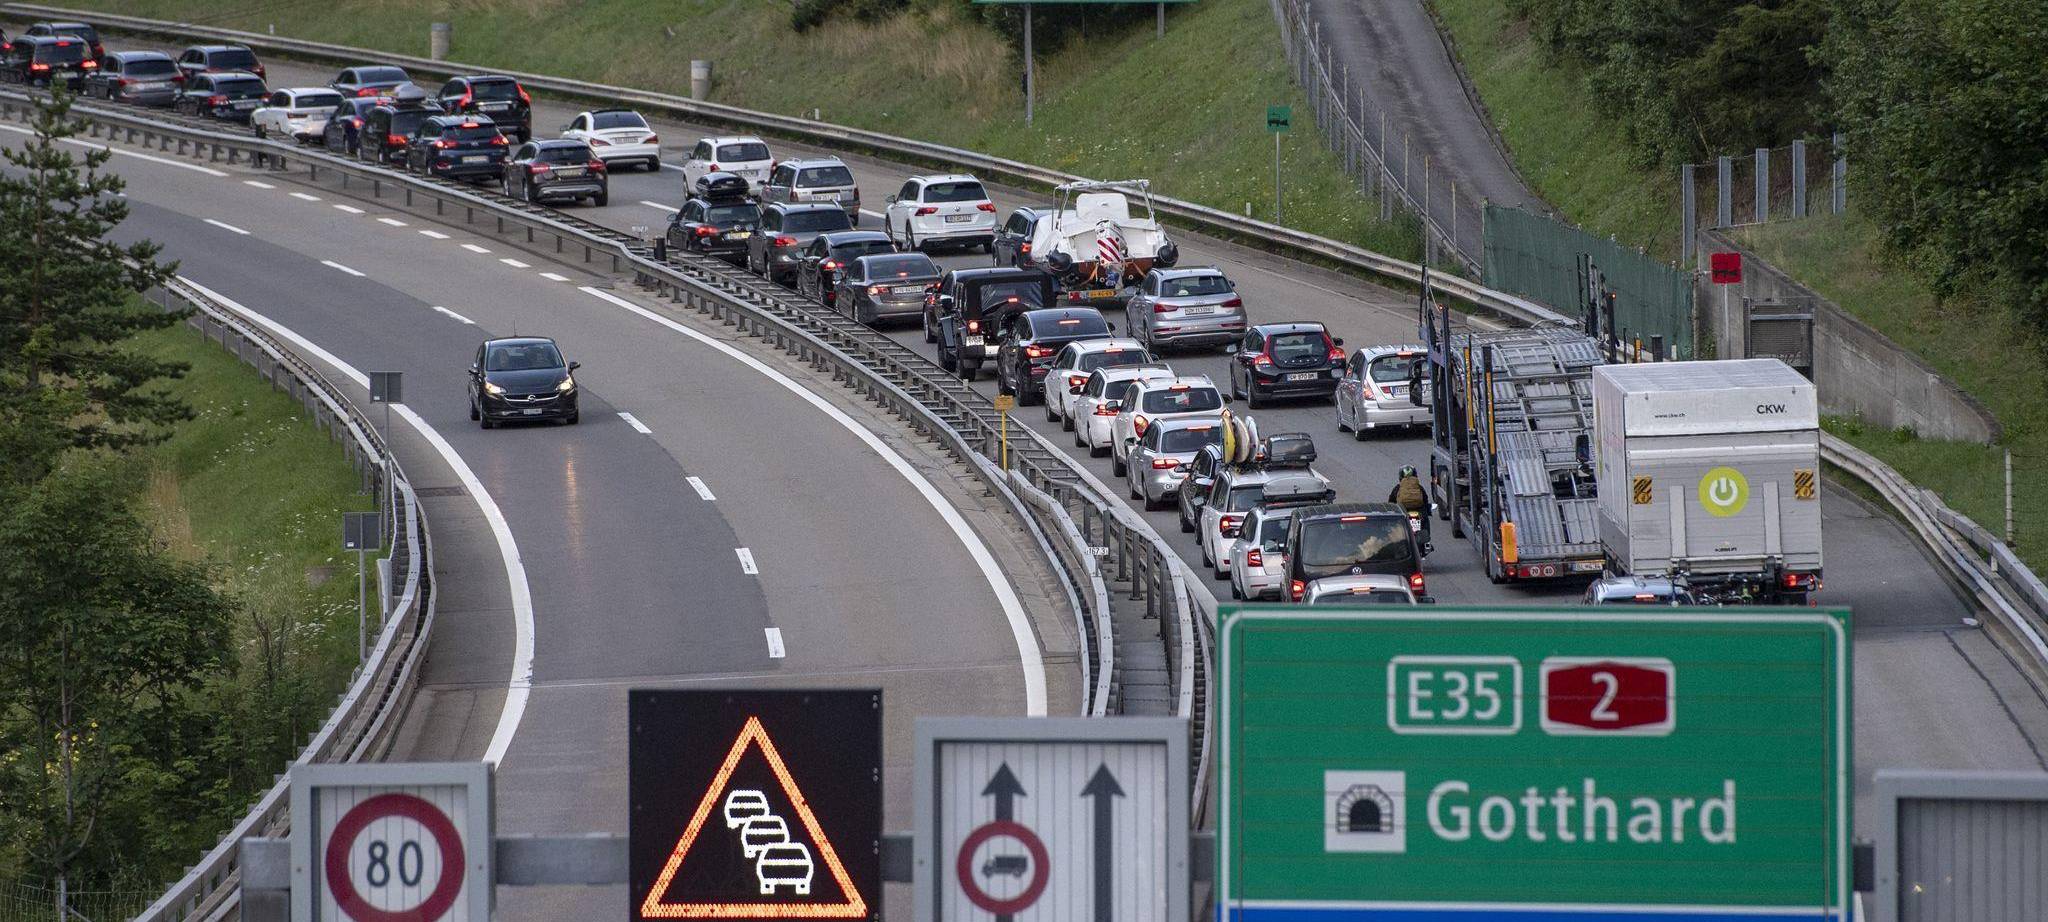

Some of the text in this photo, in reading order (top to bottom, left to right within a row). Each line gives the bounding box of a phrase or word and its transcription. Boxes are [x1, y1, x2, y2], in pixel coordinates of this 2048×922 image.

[1408, 670, 1501, 721] E35
[1590, 671, 1619, 721] 2
[1426, 778, 1736, 844] Gotthard
[366, 840, 424, 888] 80
